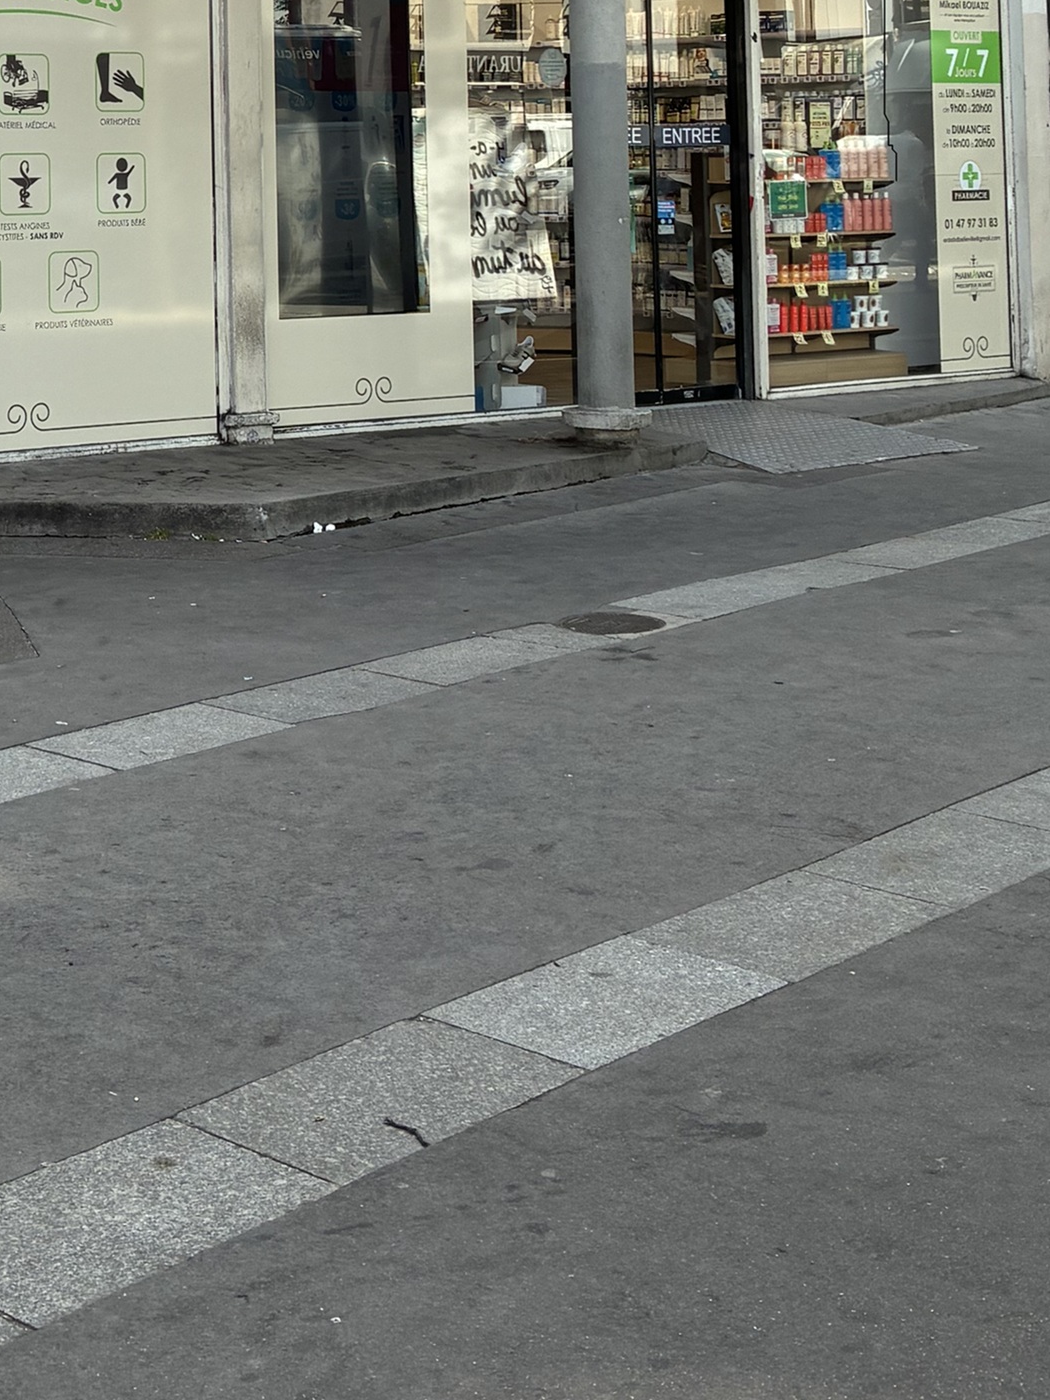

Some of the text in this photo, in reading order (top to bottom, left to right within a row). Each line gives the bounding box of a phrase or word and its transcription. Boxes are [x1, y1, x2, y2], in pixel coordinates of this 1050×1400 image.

[952, 31, 980, 41] OUVERT
[945, 88, 965, 98] LUNDI
[971, 88, 996, 98] SAMEDI
[25, 119, 57, 130] MÉDICAL
[100, 117, 141, 126] ORTHOPÉDIE
[951, 124, 991, 135] DIMANCHE
[662, 126, 722, 144] ENTREE
[953, 190, 989, 200] PHARMACIE
[0, 221, 51, 231] TESTS ANGINES
[97, 218, 130, 228] PRODUITS
[944, 219, 954, 229] 01
[955, 218, 966, 228] 47
[978, 217, 987, 227] 31
[29, 232, 49, 241] SANS
[49, 231, 65, 241] RDV
[35, 320, 68, 330] PRODUITS
